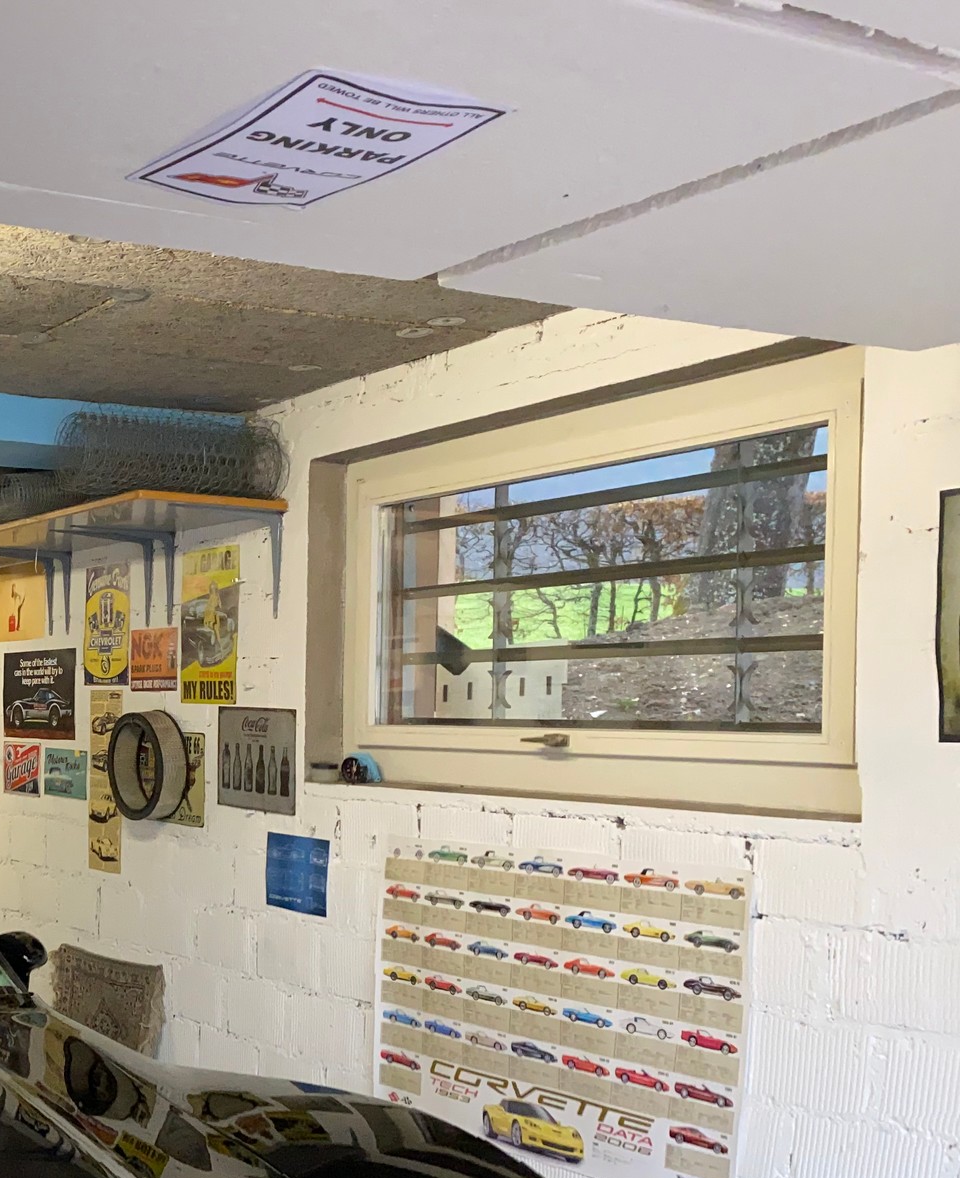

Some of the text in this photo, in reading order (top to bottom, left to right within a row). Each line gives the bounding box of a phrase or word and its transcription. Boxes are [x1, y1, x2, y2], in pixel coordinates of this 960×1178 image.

[317, 82, 362, 100] TOWED
[362, 97, 382, 106] BE
[384, 102, 411, 114] WILL
[413, 108, 460, 118] OTHERS
[306, 117, 412, 143] ONLY
[246, 131, 407, 165] PARKING
[213, 151, 362, 180] CORVETTE
[90, 636, 122, 647] CHEVROLET
[131, 632, 163, 660] NGK
[20, 658, 31, 668] Some
[183, 680, 234, 700] MY RULES!
[6, 756, 38, 782] Garage
[430, 1076, 478, 1098] TECH
[430, 1060, 654, 1133] CORVETTE
[597, 1123, 653, 1146] DATA
